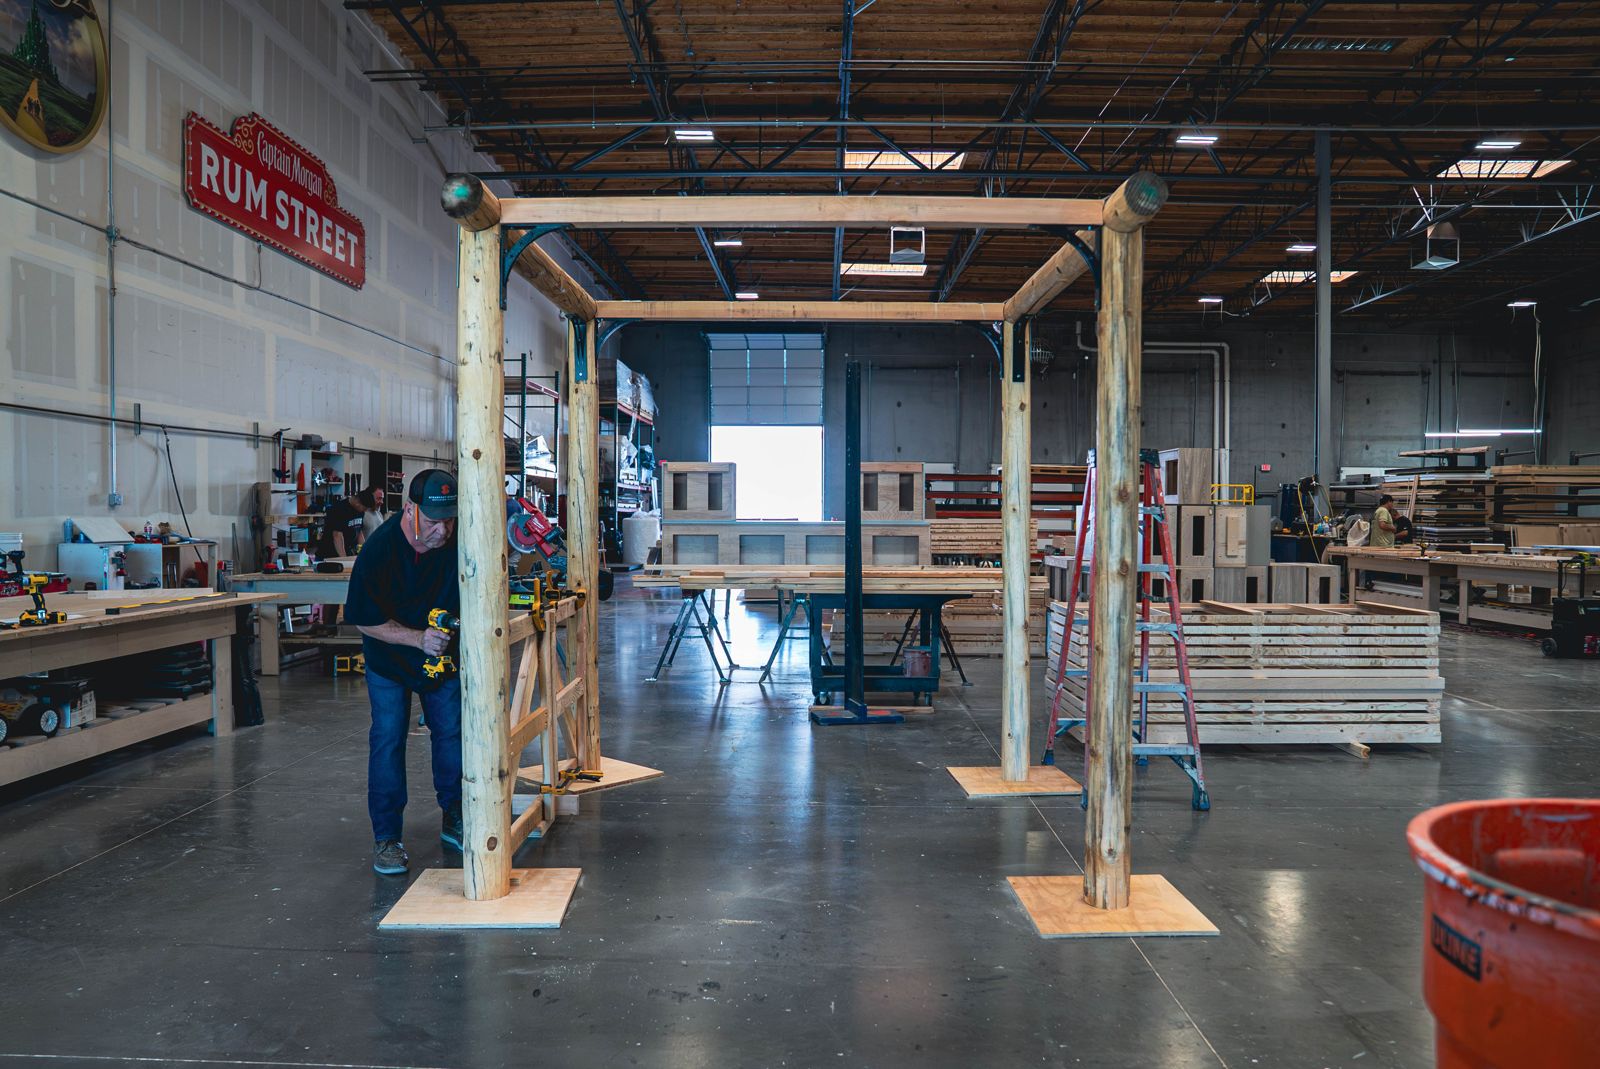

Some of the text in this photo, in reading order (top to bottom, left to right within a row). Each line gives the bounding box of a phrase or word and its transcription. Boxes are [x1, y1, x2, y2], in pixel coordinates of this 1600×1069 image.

[201, 142, 358, 268] RUM STREET
[257, 131, 323, 200] Captain Morgan
